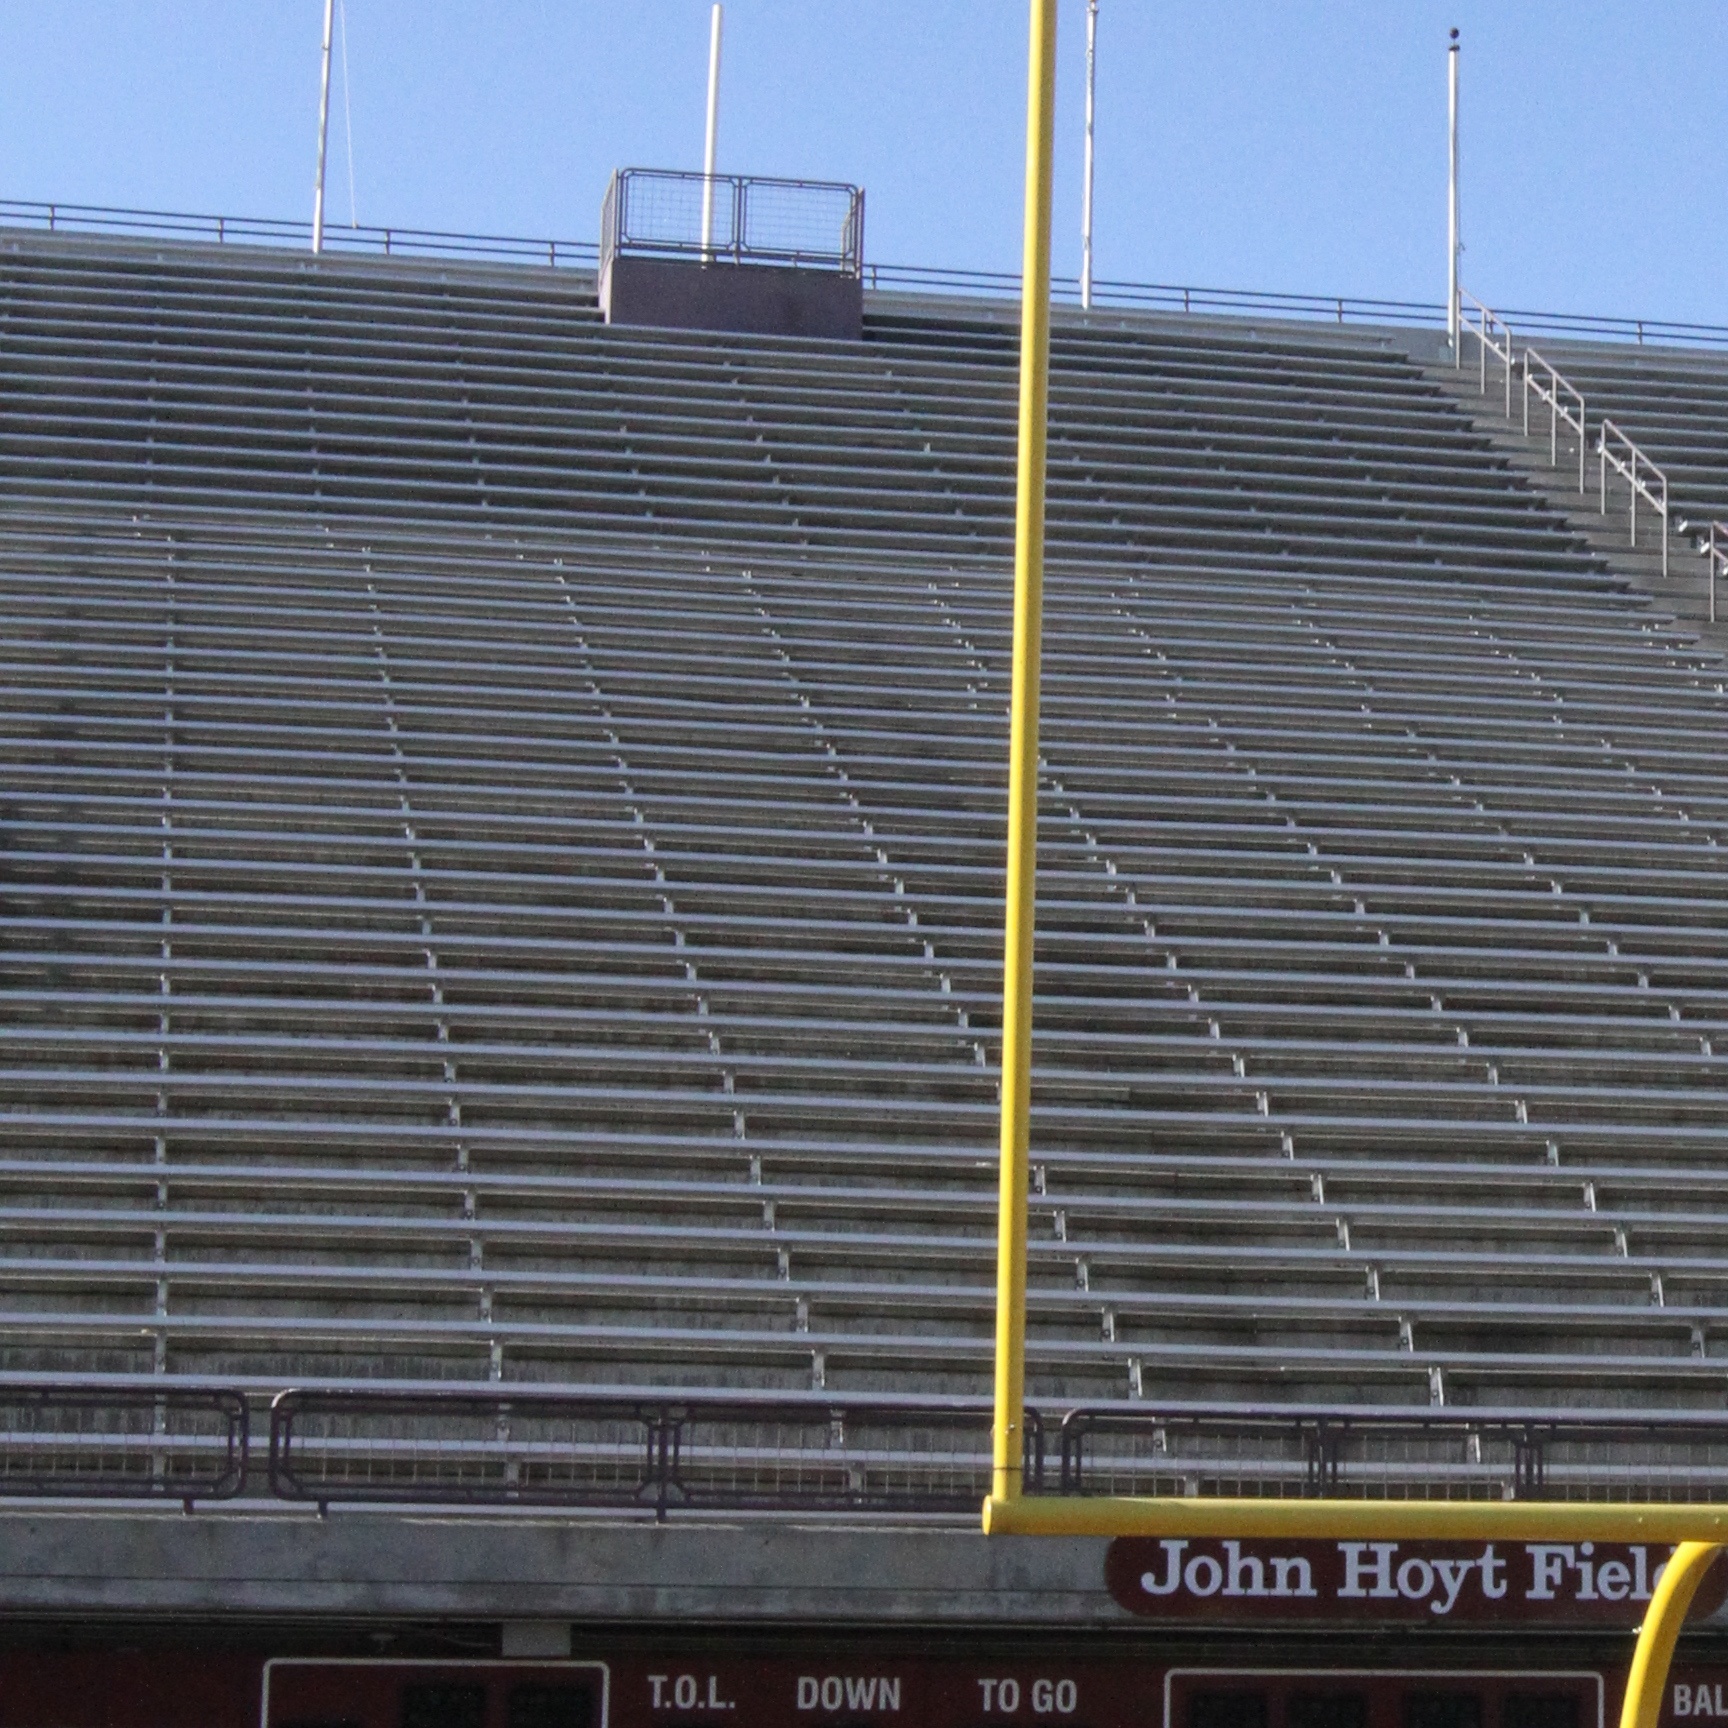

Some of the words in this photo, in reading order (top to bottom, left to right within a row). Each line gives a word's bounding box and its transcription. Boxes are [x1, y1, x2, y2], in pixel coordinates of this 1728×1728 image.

[1140, 1539, 1318, 1598] John
[1336, 1542, 1508, 1614] Hoyt
[1525, 1542, 1674, 1601] Fiel
[647, 1674, 736, 1710] T.O.L.
[797, 1676, 901, 1712] DOWN
[978, 1678, 1020, 1713] TO
[1031, 1678, 1077, 1714] GO
